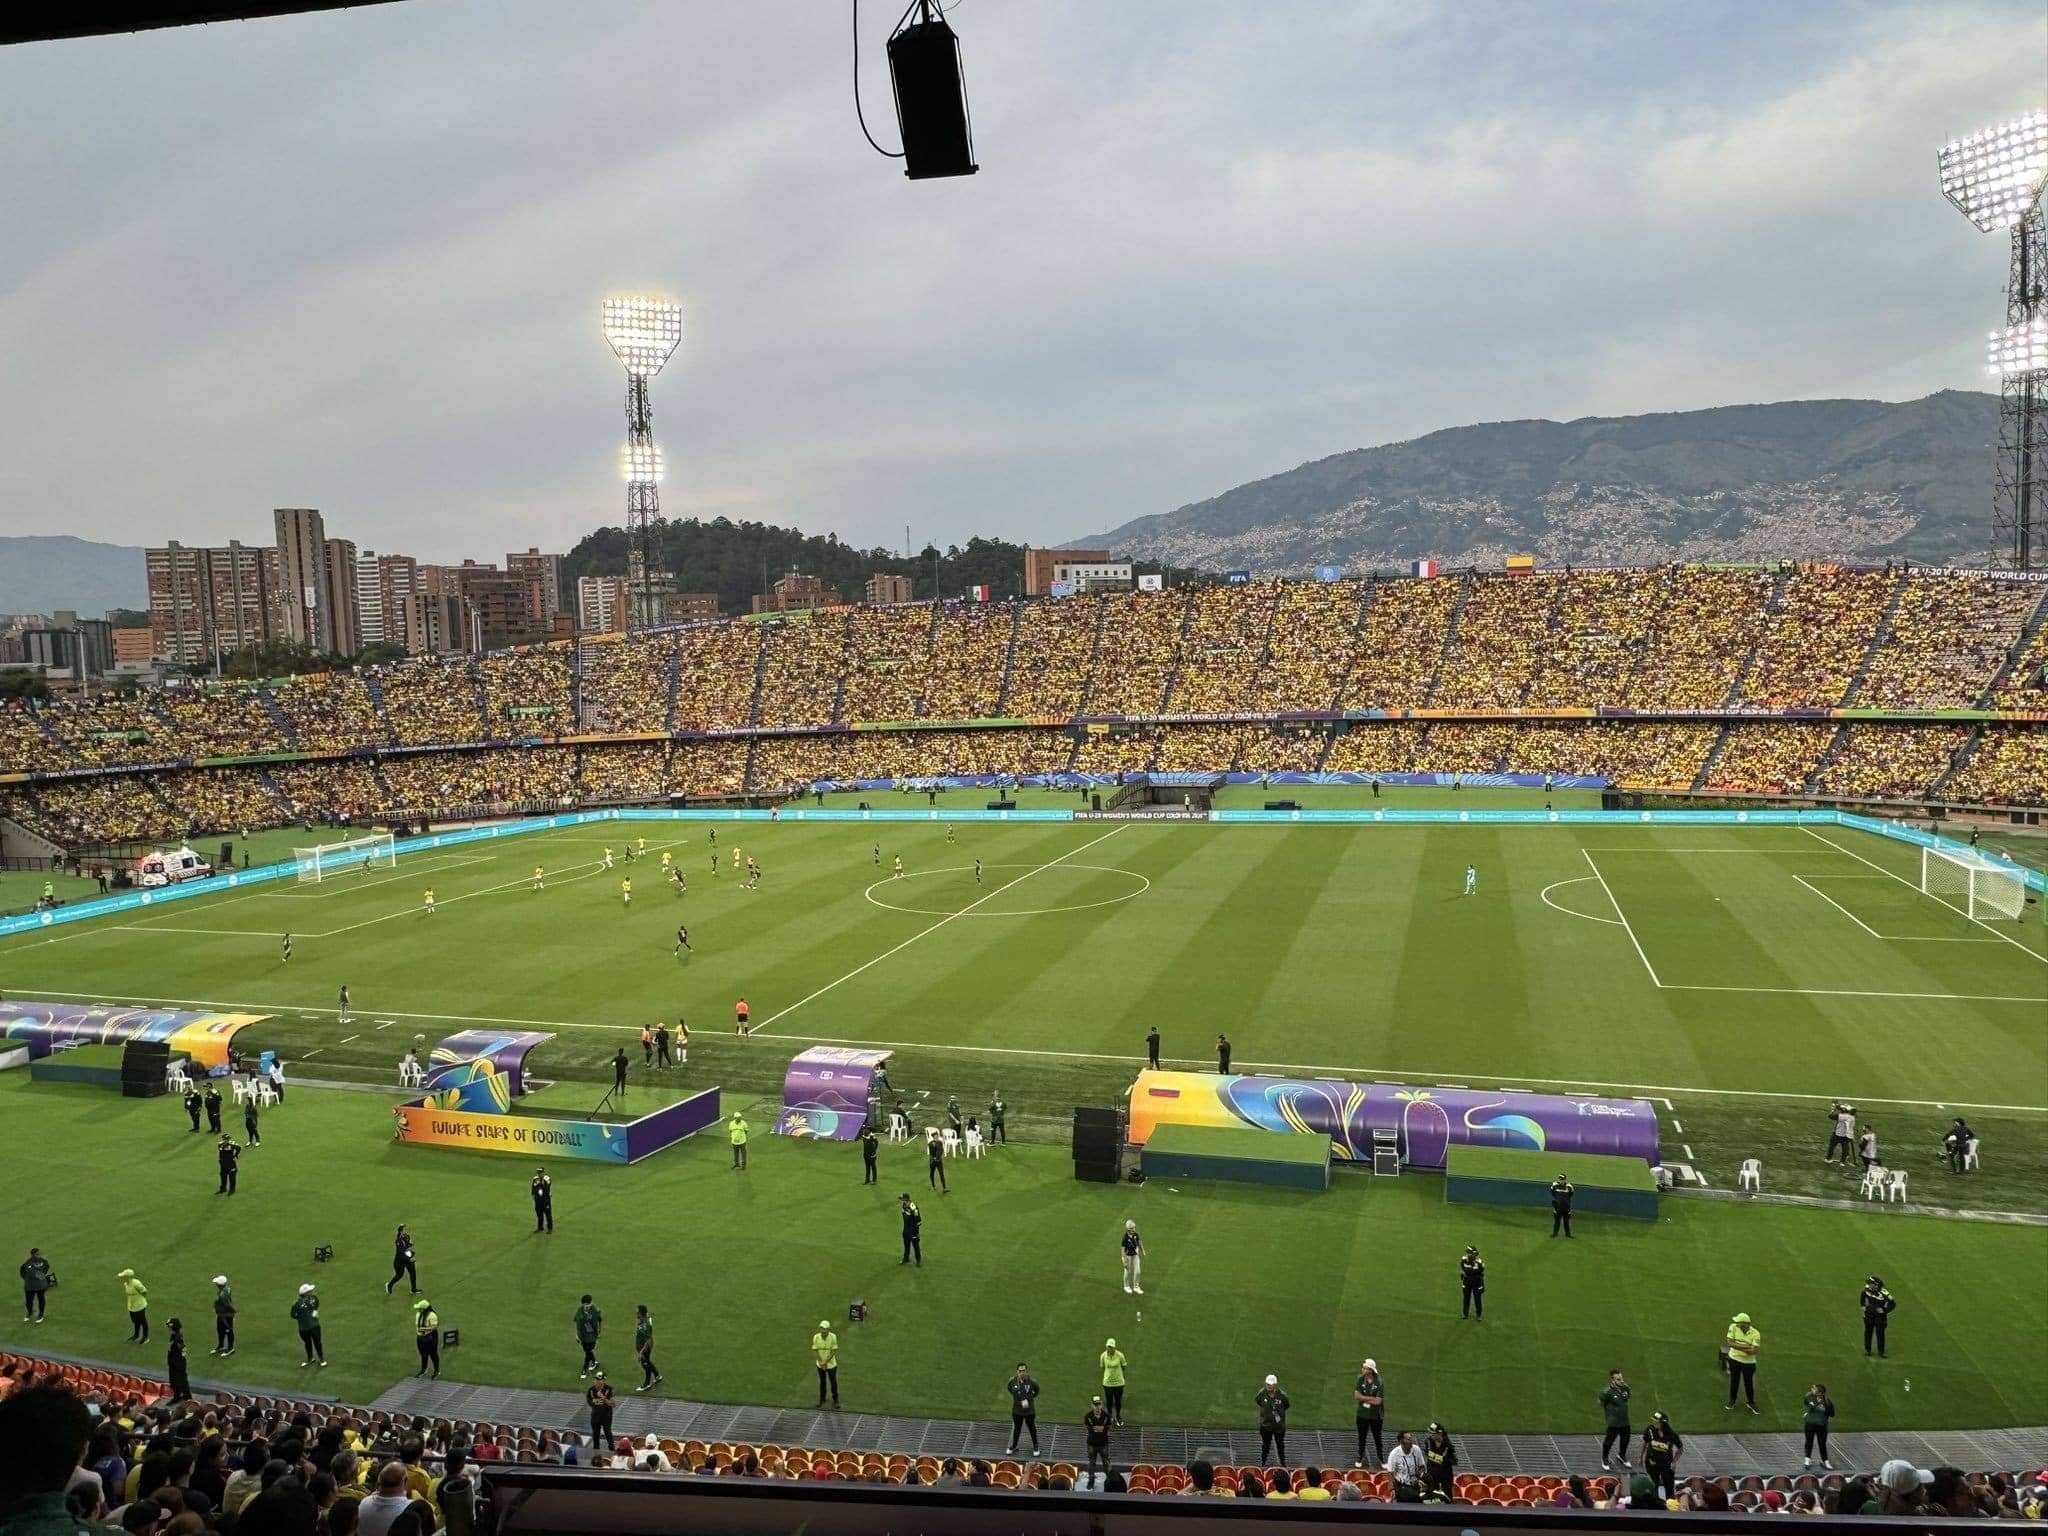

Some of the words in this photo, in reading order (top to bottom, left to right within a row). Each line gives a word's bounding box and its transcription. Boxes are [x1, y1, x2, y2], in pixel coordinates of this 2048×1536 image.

[1990, 570, 2026, 581] WORLD
[431, 1120, 471, 1137] FUTURE
[475, 1125, 509, 1140] STARS
[513, 1128, 528, 1142] OF
